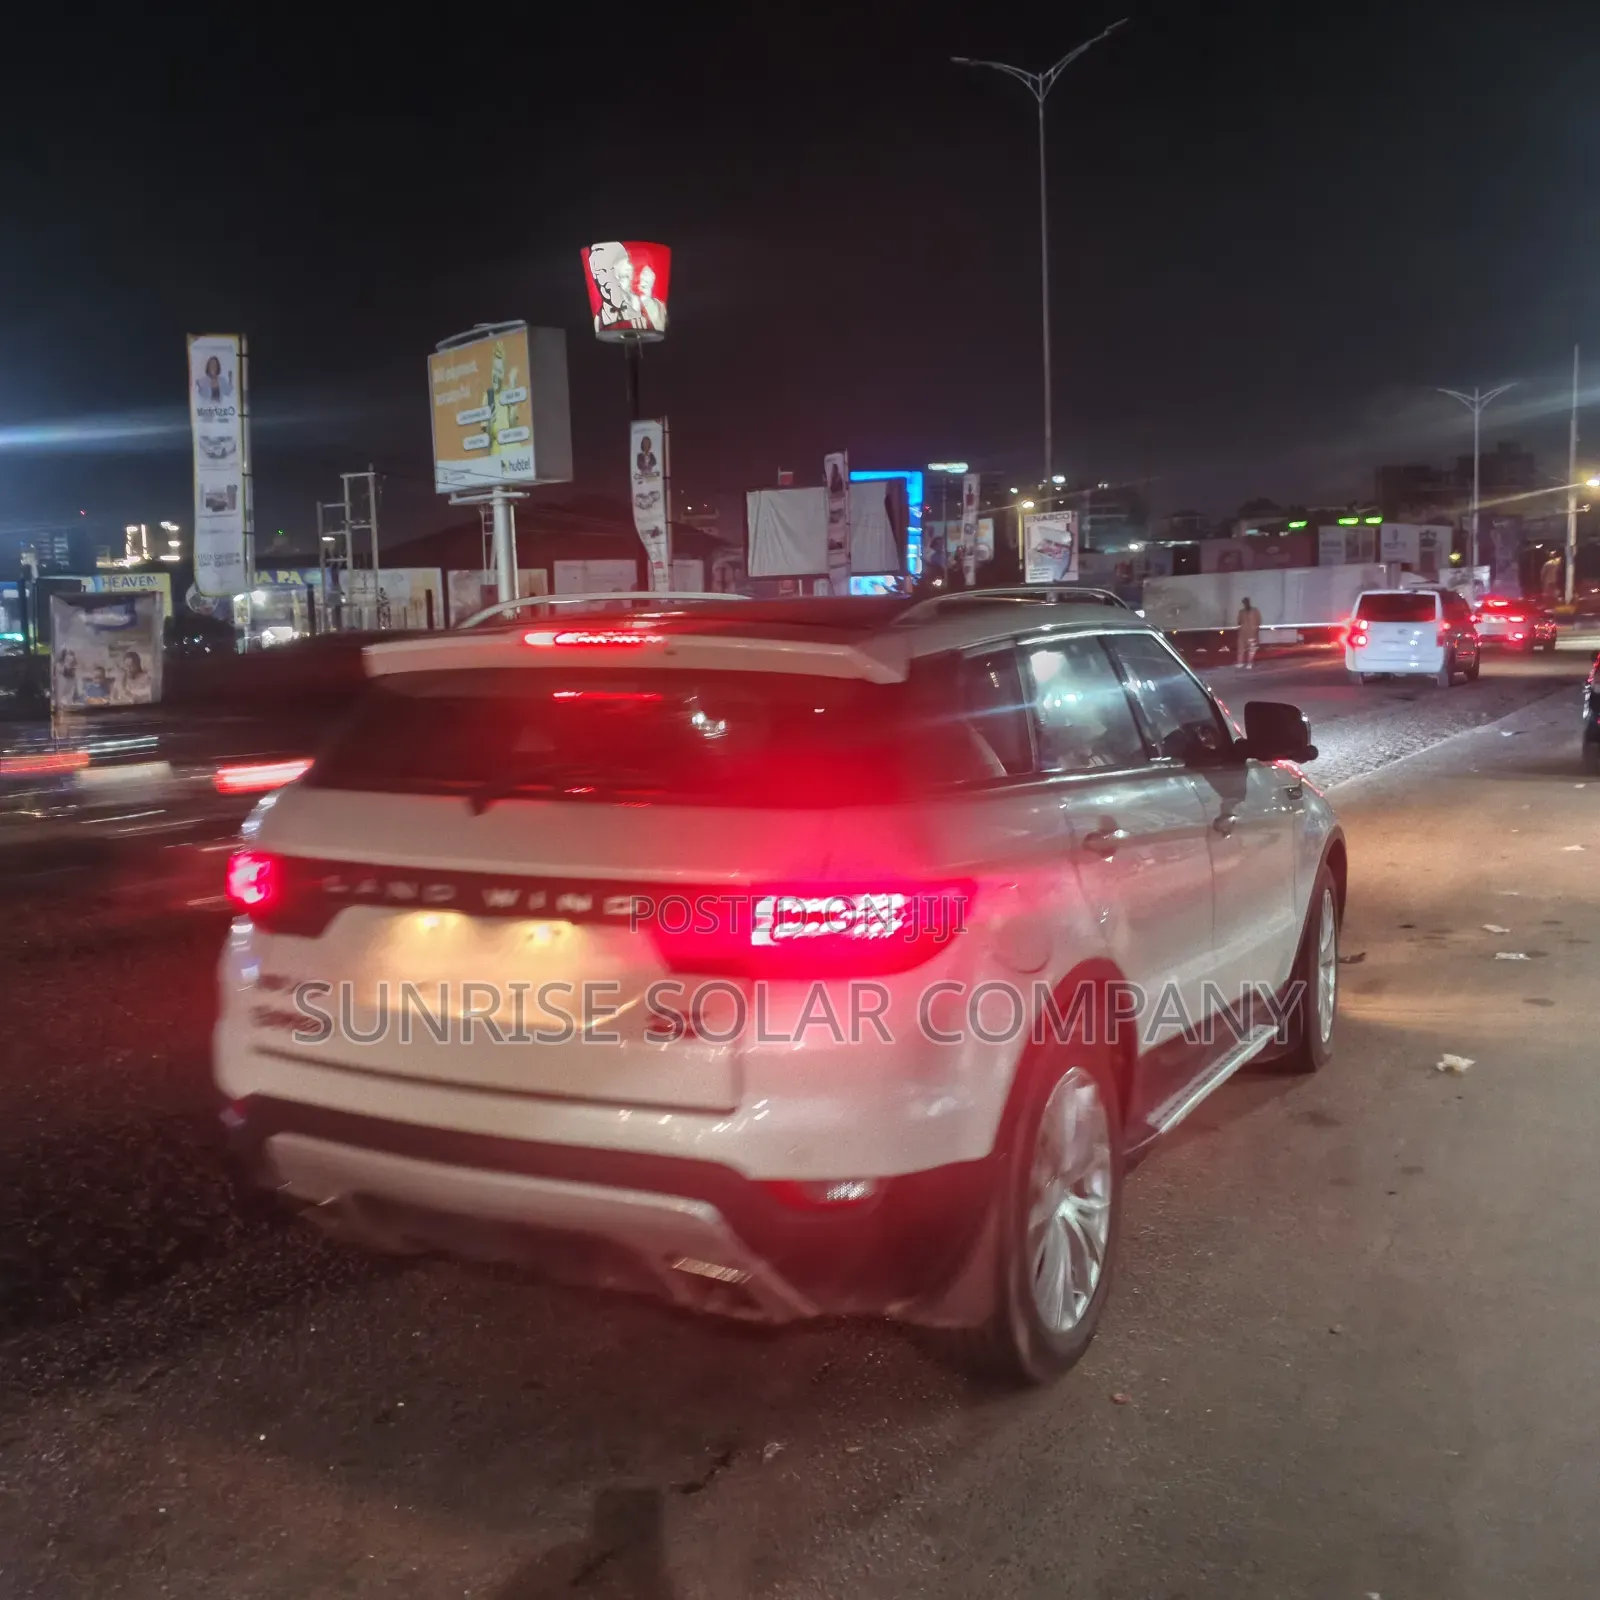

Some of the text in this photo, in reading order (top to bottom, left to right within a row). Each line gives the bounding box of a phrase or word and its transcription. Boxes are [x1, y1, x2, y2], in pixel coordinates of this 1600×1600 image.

[509, 458, 531, 472] hubtel
[1033, 512, 1069, 522] NASCO
[322, 874, 638, 916] LAND WIND
